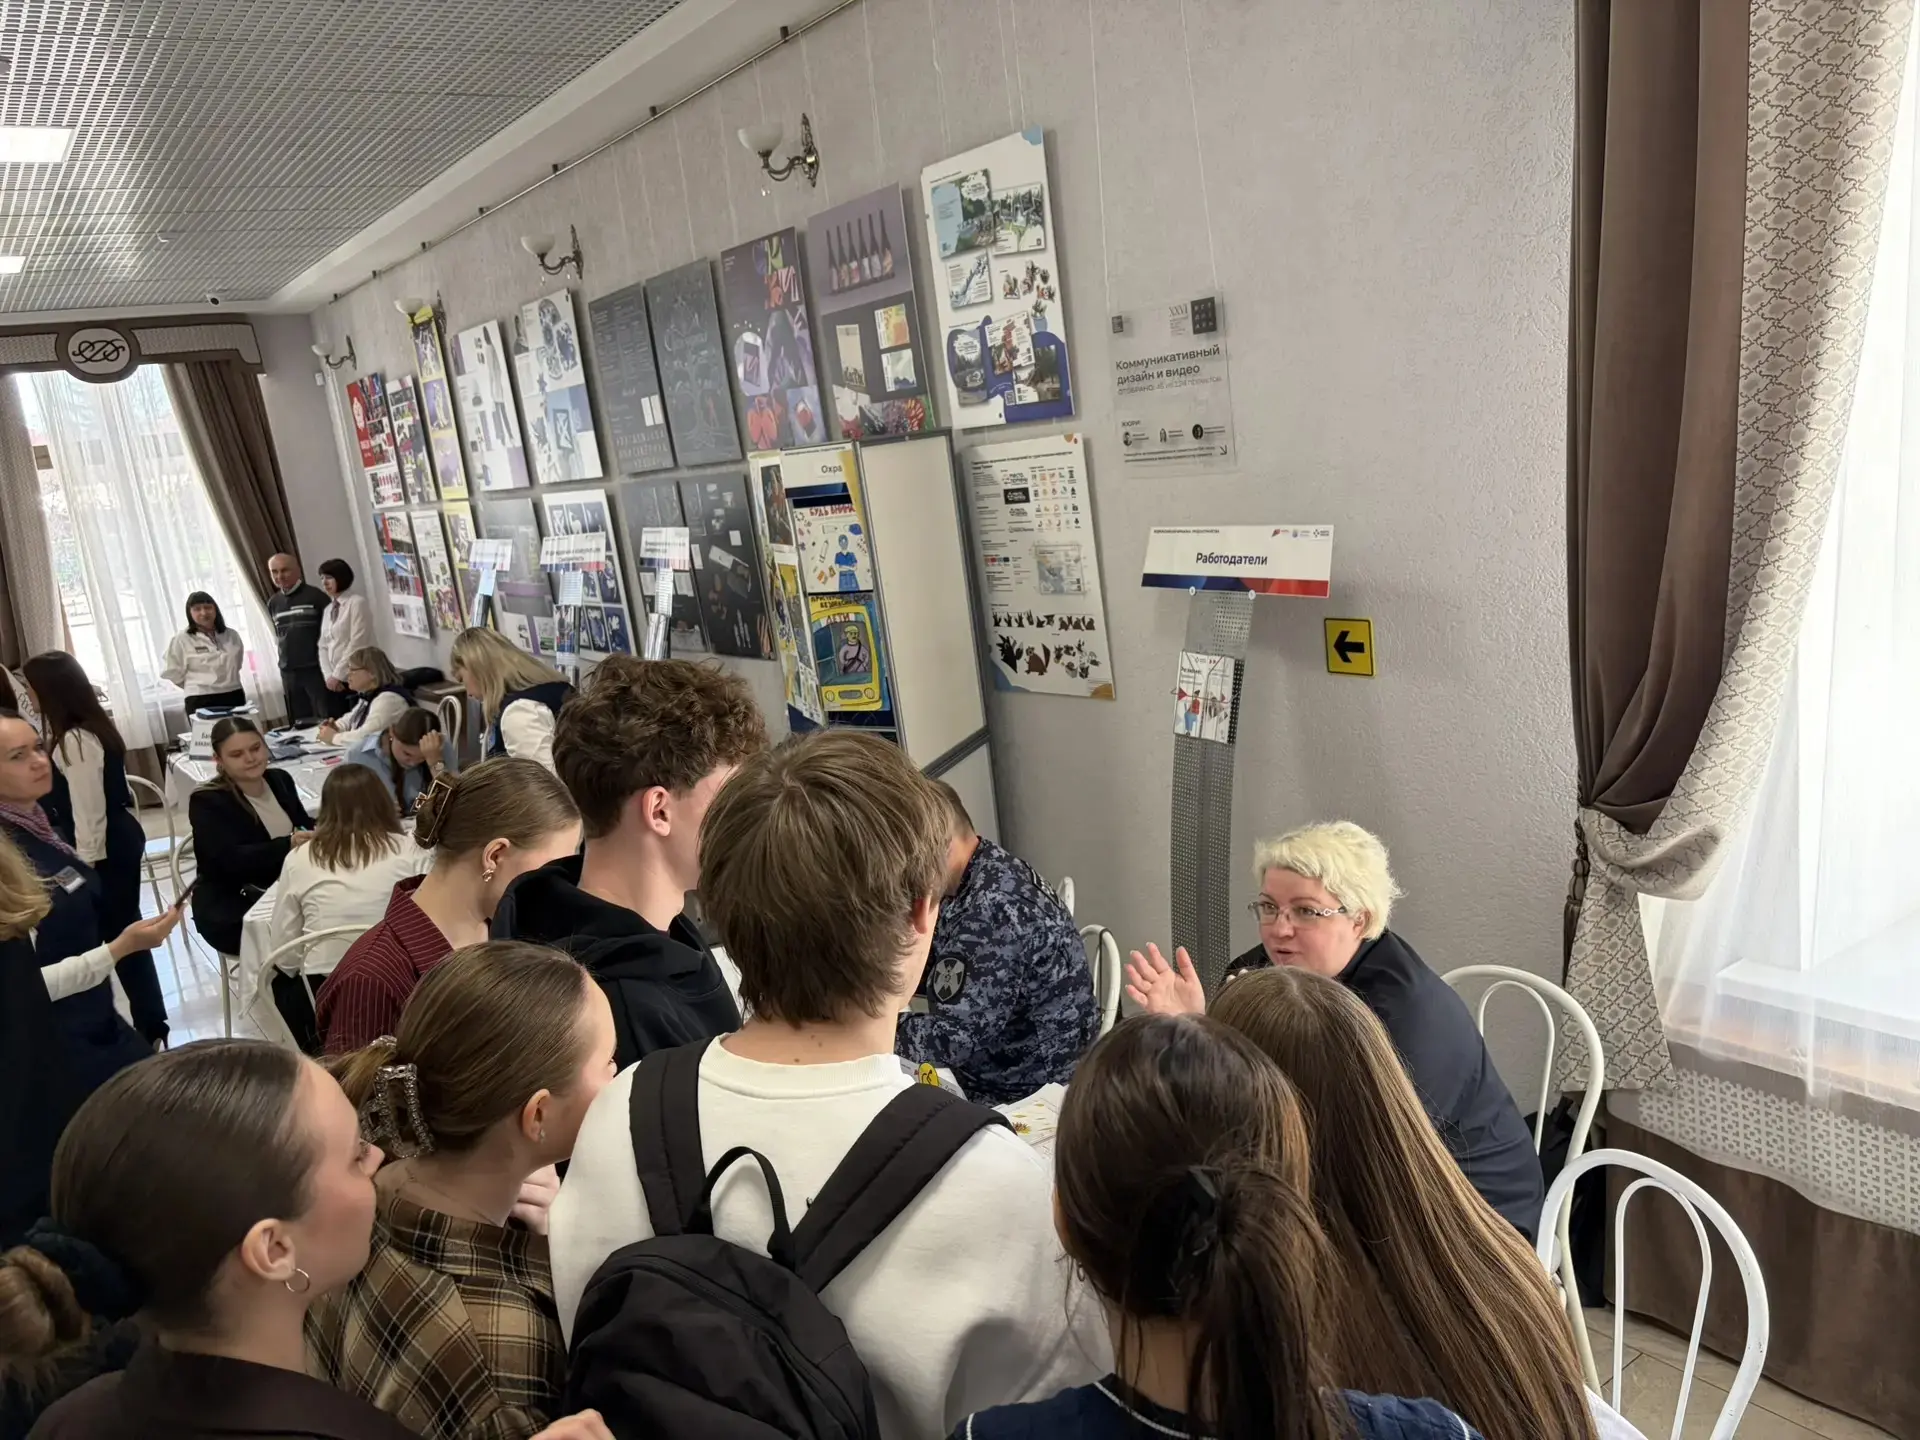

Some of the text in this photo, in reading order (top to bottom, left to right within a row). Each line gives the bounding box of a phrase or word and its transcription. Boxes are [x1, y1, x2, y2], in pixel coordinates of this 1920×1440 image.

[1115, 344, 1220, 371] Коммуникативный
[1116, 365, 1200, 387] дизайн и видео
[1195, 552, 1268, 566] Работодатели
